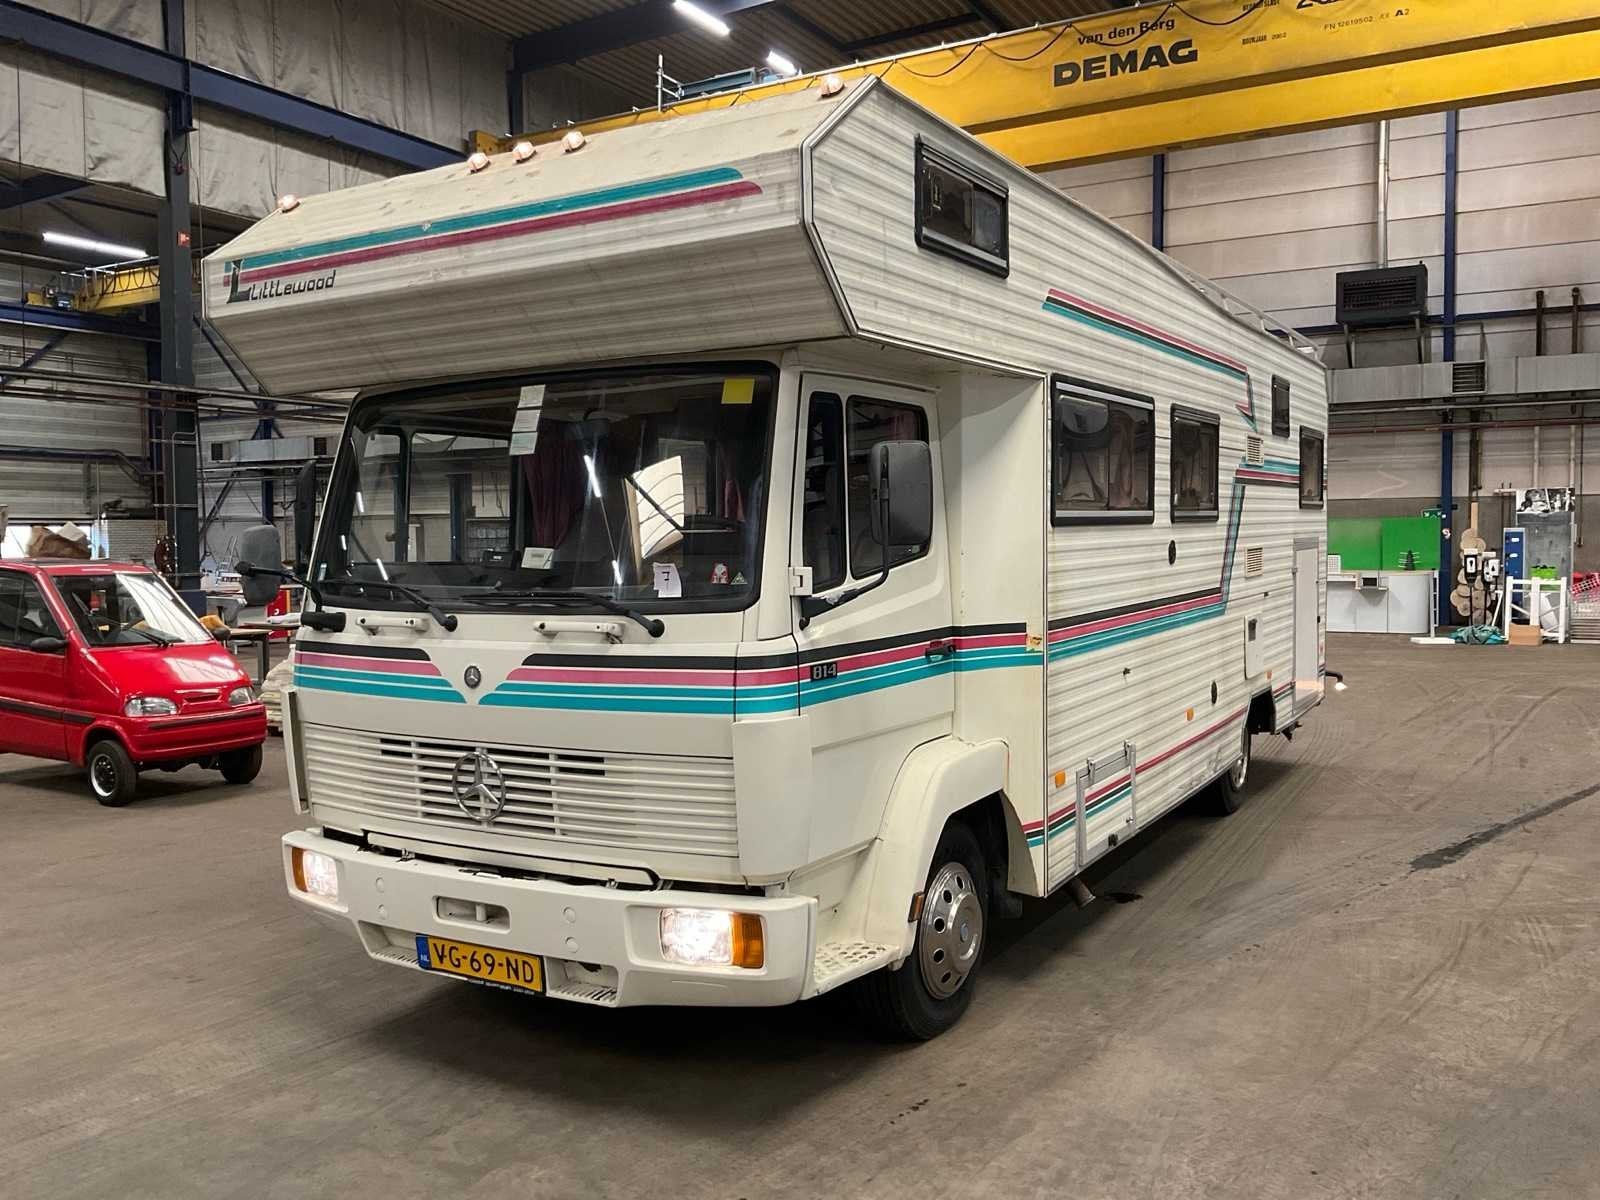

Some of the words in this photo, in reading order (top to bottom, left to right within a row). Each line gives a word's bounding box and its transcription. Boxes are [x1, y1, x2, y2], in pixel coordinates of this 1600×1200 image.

[1078, 33, 1103, 45] van
[1108, 28, 1135, 40] den
[1139, 19, 1175, 34] Berg
[1054, 39, 1198, 87] DEMAG
[813, 663, 837, 680] 814
[432, 943, 534, 983] VG-69-ND
